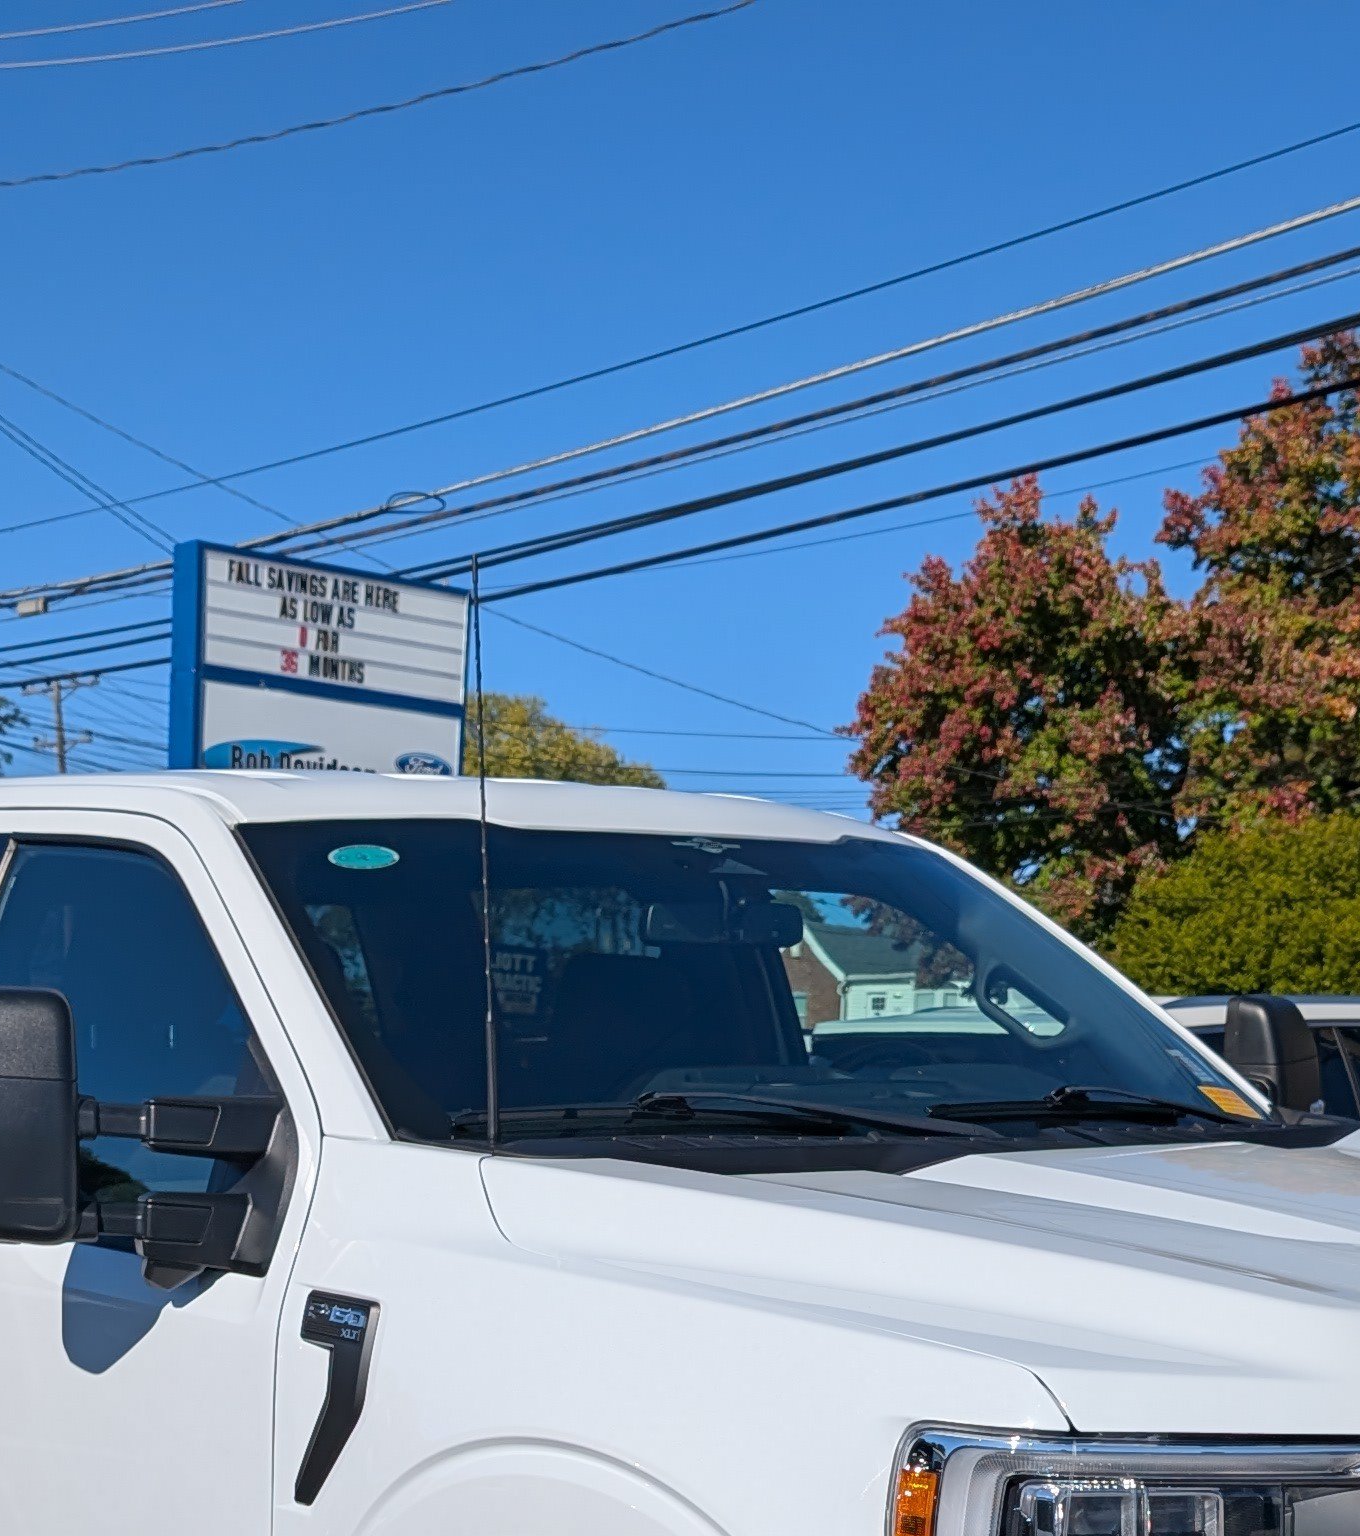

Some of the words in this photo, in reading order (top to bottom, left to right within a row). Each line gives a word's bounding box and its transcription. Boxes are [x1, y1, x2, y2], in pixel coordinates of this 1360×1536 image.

[228, 559, 262, 587] FALL
[266, 566, 328, 598] SAVINGS
[331, 578, 359, 604] ARE
[364, 583, 400, 613] HERE
[279, 597, 298, 619] AS
[303, 600, 333, 625] LOW
[337, 606, 356, 629] AS
[315, 629, 340, 653] FOR
[308, 654, 366, 684] MONTHS
